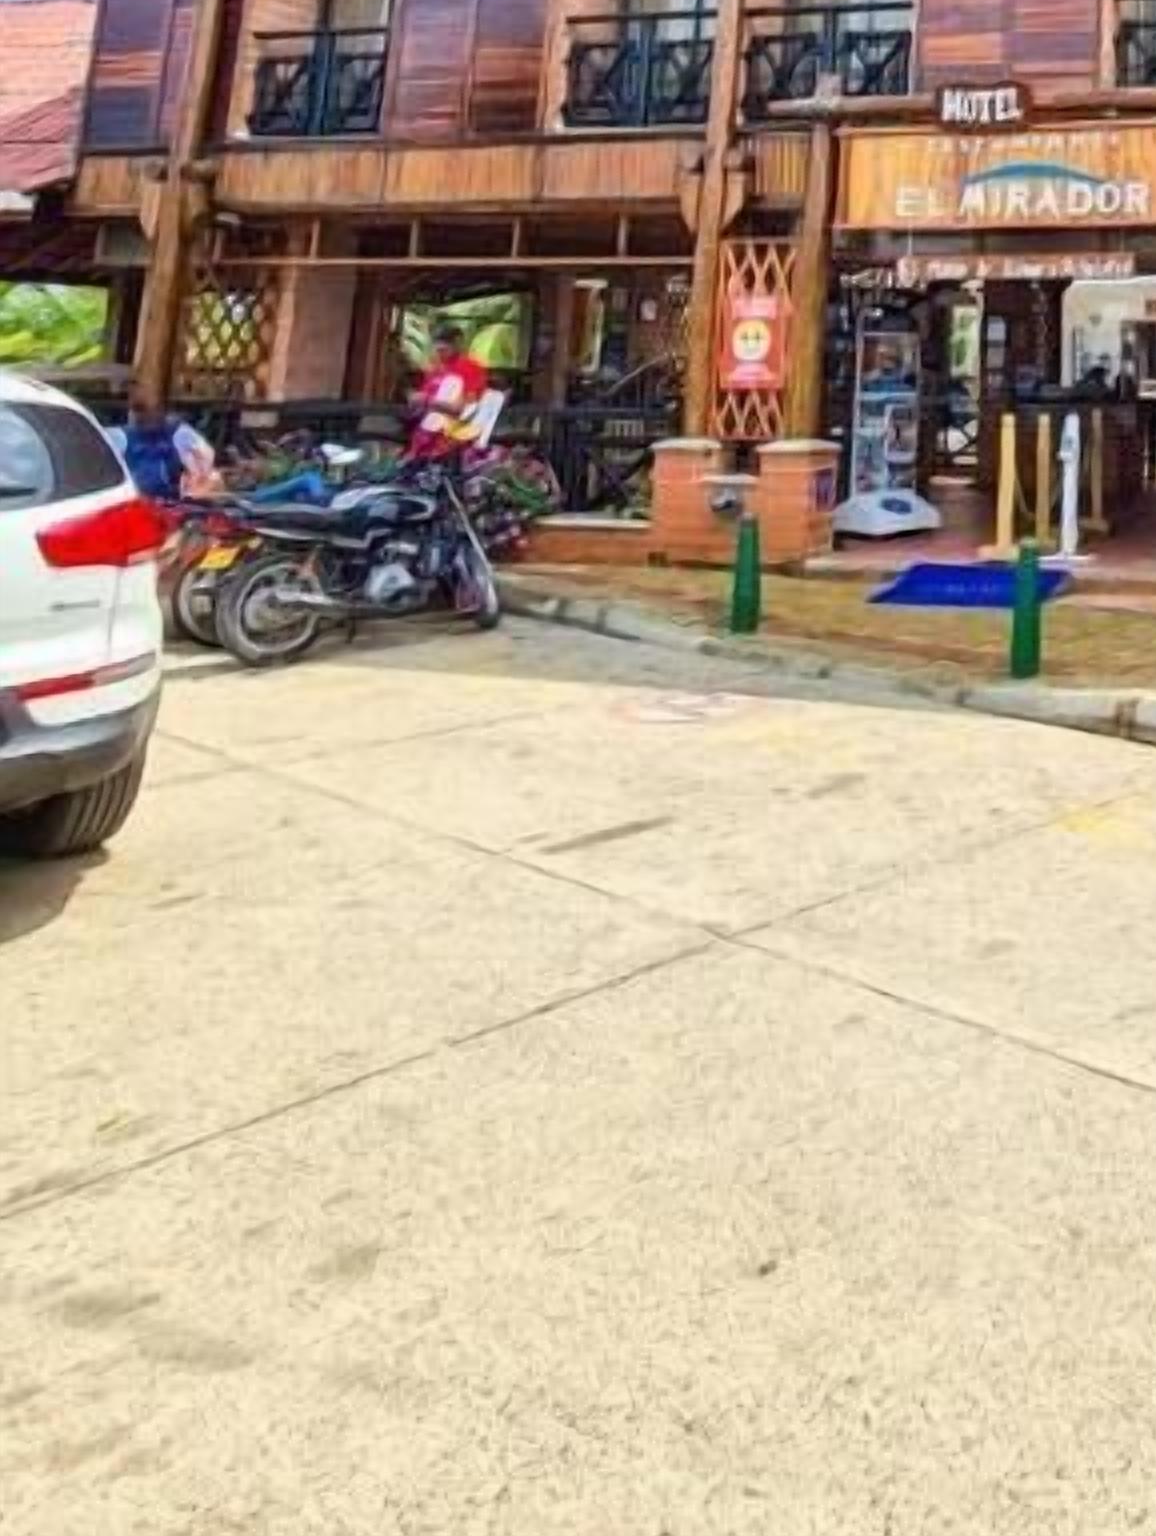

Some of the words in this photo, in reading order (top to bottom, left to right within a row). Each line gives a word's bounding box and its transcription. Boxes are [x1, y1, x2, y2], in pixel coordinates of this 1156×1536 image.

[942, 87, 1023, 122] HOTEL
[895, 186, 948, 217] EL
[959, 181, 1149, 219] MIRADOR
